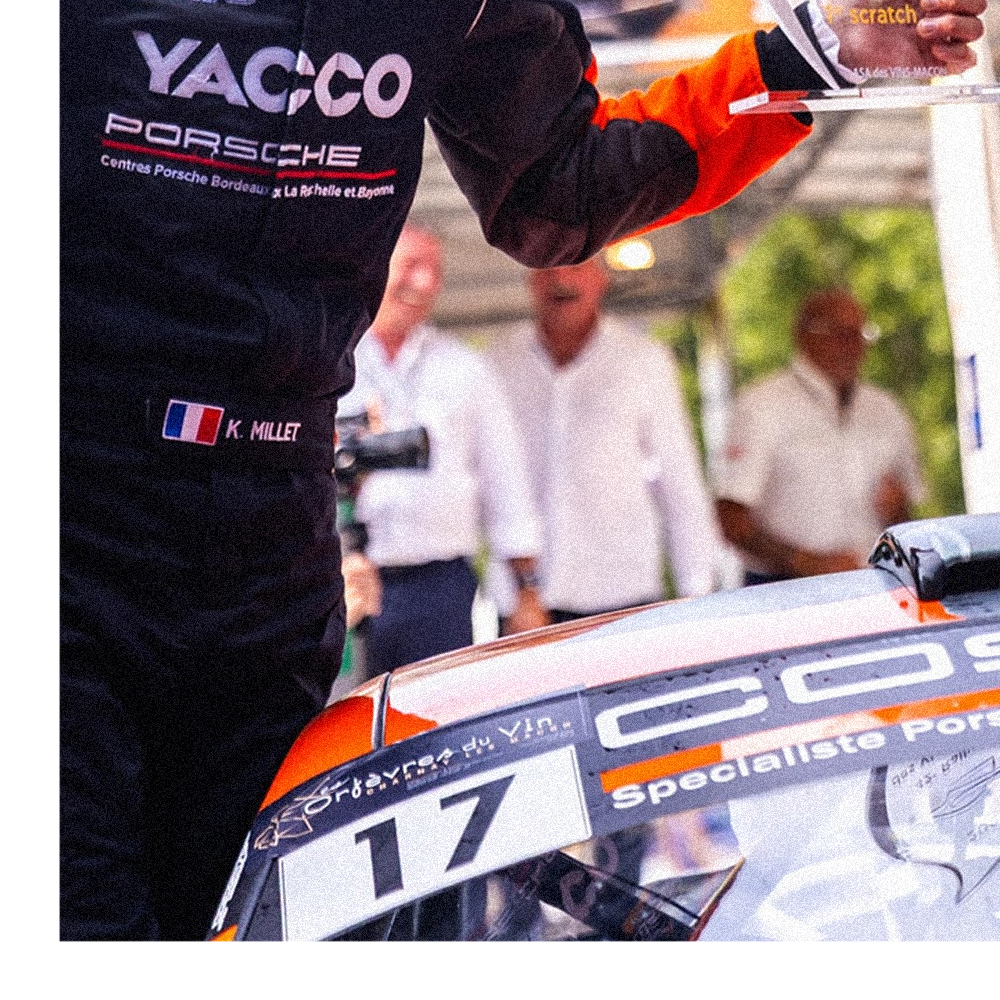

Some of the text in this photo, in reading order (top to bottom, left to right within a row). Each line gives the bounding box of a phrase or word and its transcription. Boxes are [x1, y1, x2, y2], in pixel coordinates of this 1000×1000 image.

[849, 2, 918, 25] scratch
[132, 29, 413, 119] YACCO
[104, 112, 363, 168] PORSCHE
[100, 154, 151, 176] Centres
[153, 163, 209, 186] Porsche
[284, 185, 298, 198] La
[343, 186, 357, 198] et
[225, 419, 302, 442] K. MILLET
[461, 735, 491, 753] du
[497, 716, 553, 738] Vin
[611, 724, 886, 811] Specialiste
[354, 773, 517, 900] 17
